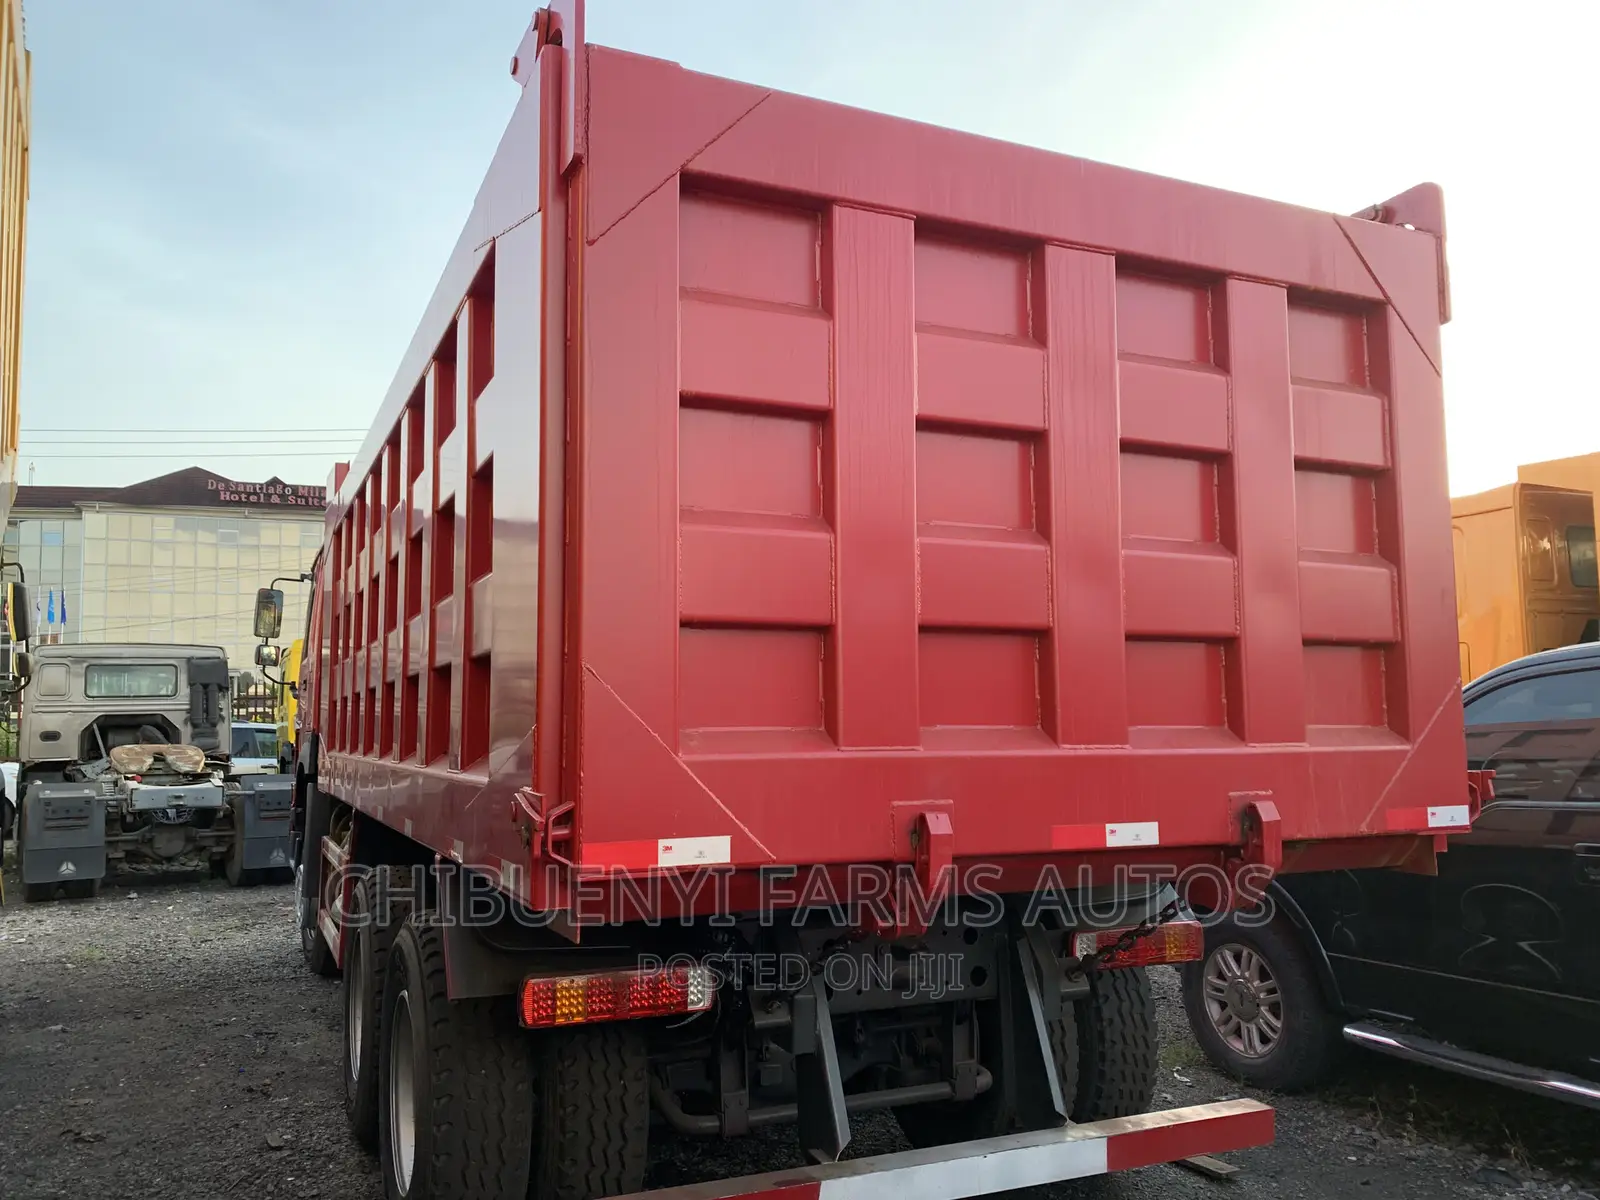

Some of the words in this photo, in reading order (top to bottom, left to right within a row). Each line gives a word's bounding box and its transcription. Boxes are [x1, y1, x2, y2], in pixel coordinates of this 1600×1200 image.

[208, 479, 225, 490] De
[229, 482, 292, 495] Santiago
[220, 491, 264, 503] Hotel
[270, 494, 281, 504] &
